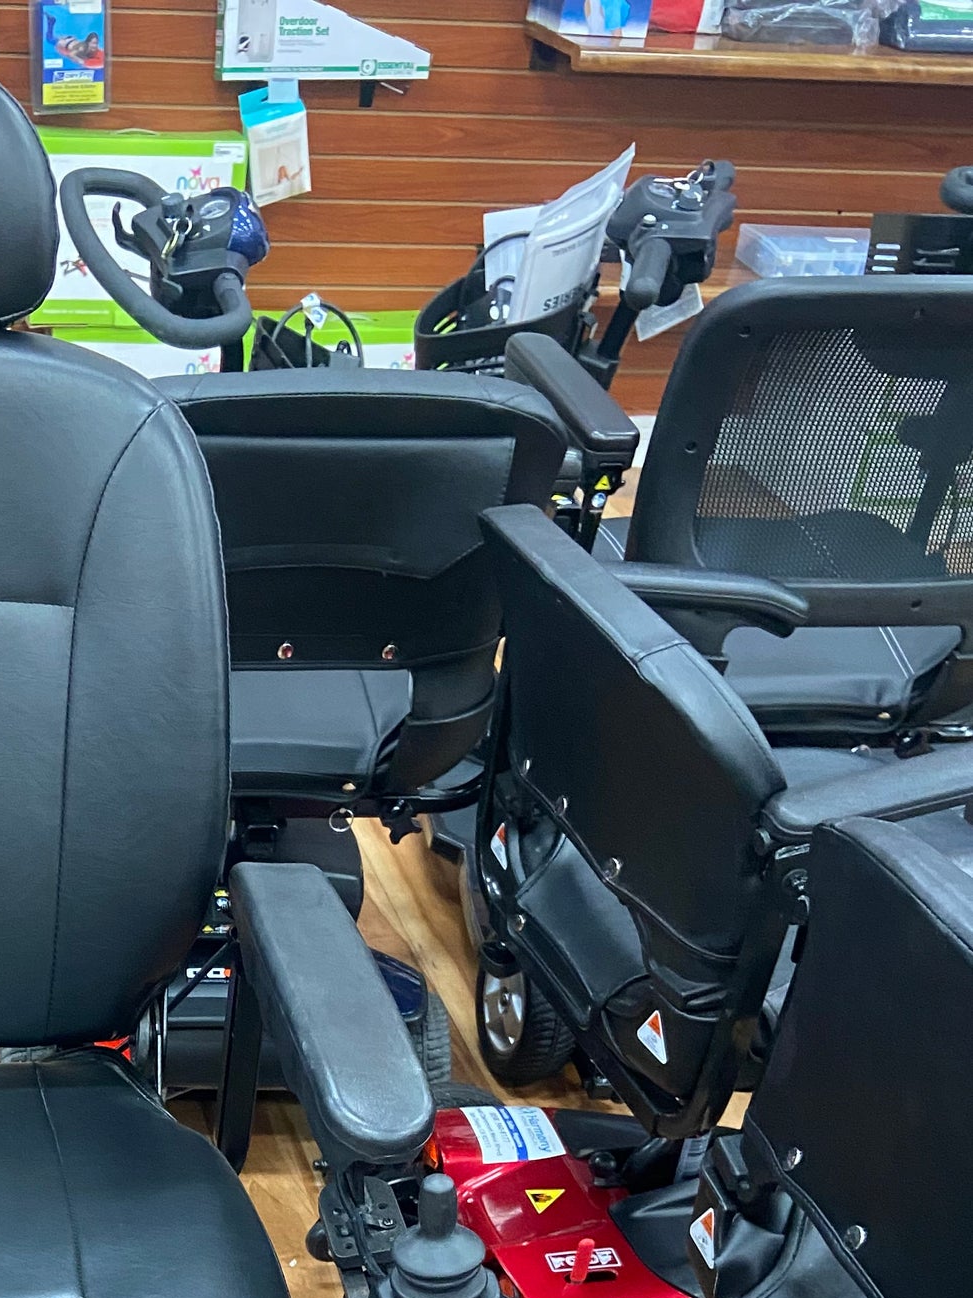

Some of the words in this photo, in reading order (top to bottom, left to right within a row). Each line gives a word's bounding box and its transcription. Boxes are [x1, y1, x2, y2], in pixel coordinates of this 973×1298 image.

[279, 16, 318, 26] Overdoor
[279, 26, 313, 36] Traction
[316, 26, 330, 36] Set
[176, 176, 220, 190] nova
[526, 1113, 551, 1151] Harmony
